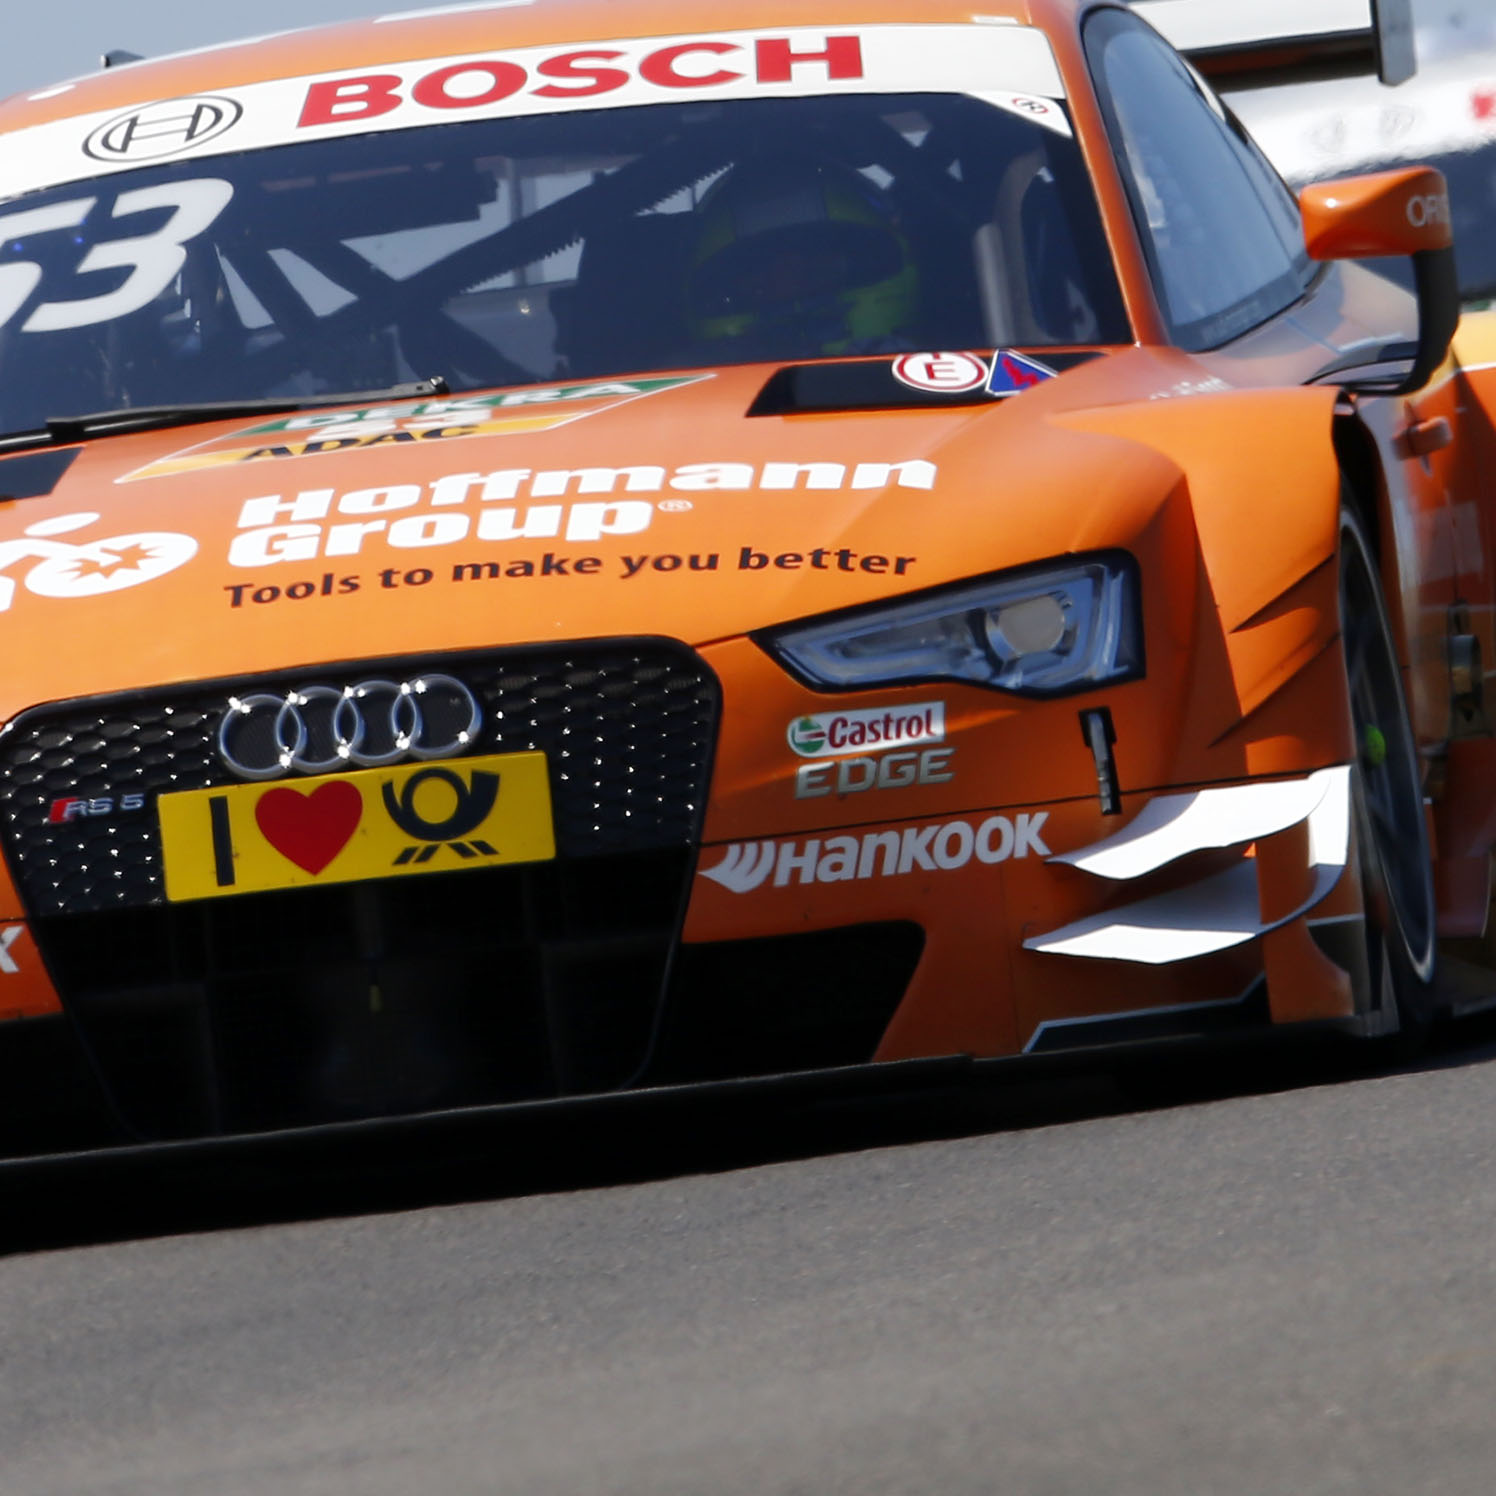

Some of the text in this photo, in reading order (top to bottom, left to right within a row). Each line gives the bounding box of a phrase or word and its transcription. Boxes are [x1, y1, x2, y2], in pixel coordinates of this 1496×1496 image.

[295, 34, 865, 129] BOSCH
[285, 383, 642, 431] DEKRA
[240, 424, 480, 462] ADAC
[236, 459, 937, 528] Hoffmann
[223, 546, 918, 608] Tools to make you better
[827, 708, 936, 749] Castrol
[794, 747, 958, 801] EDGE
